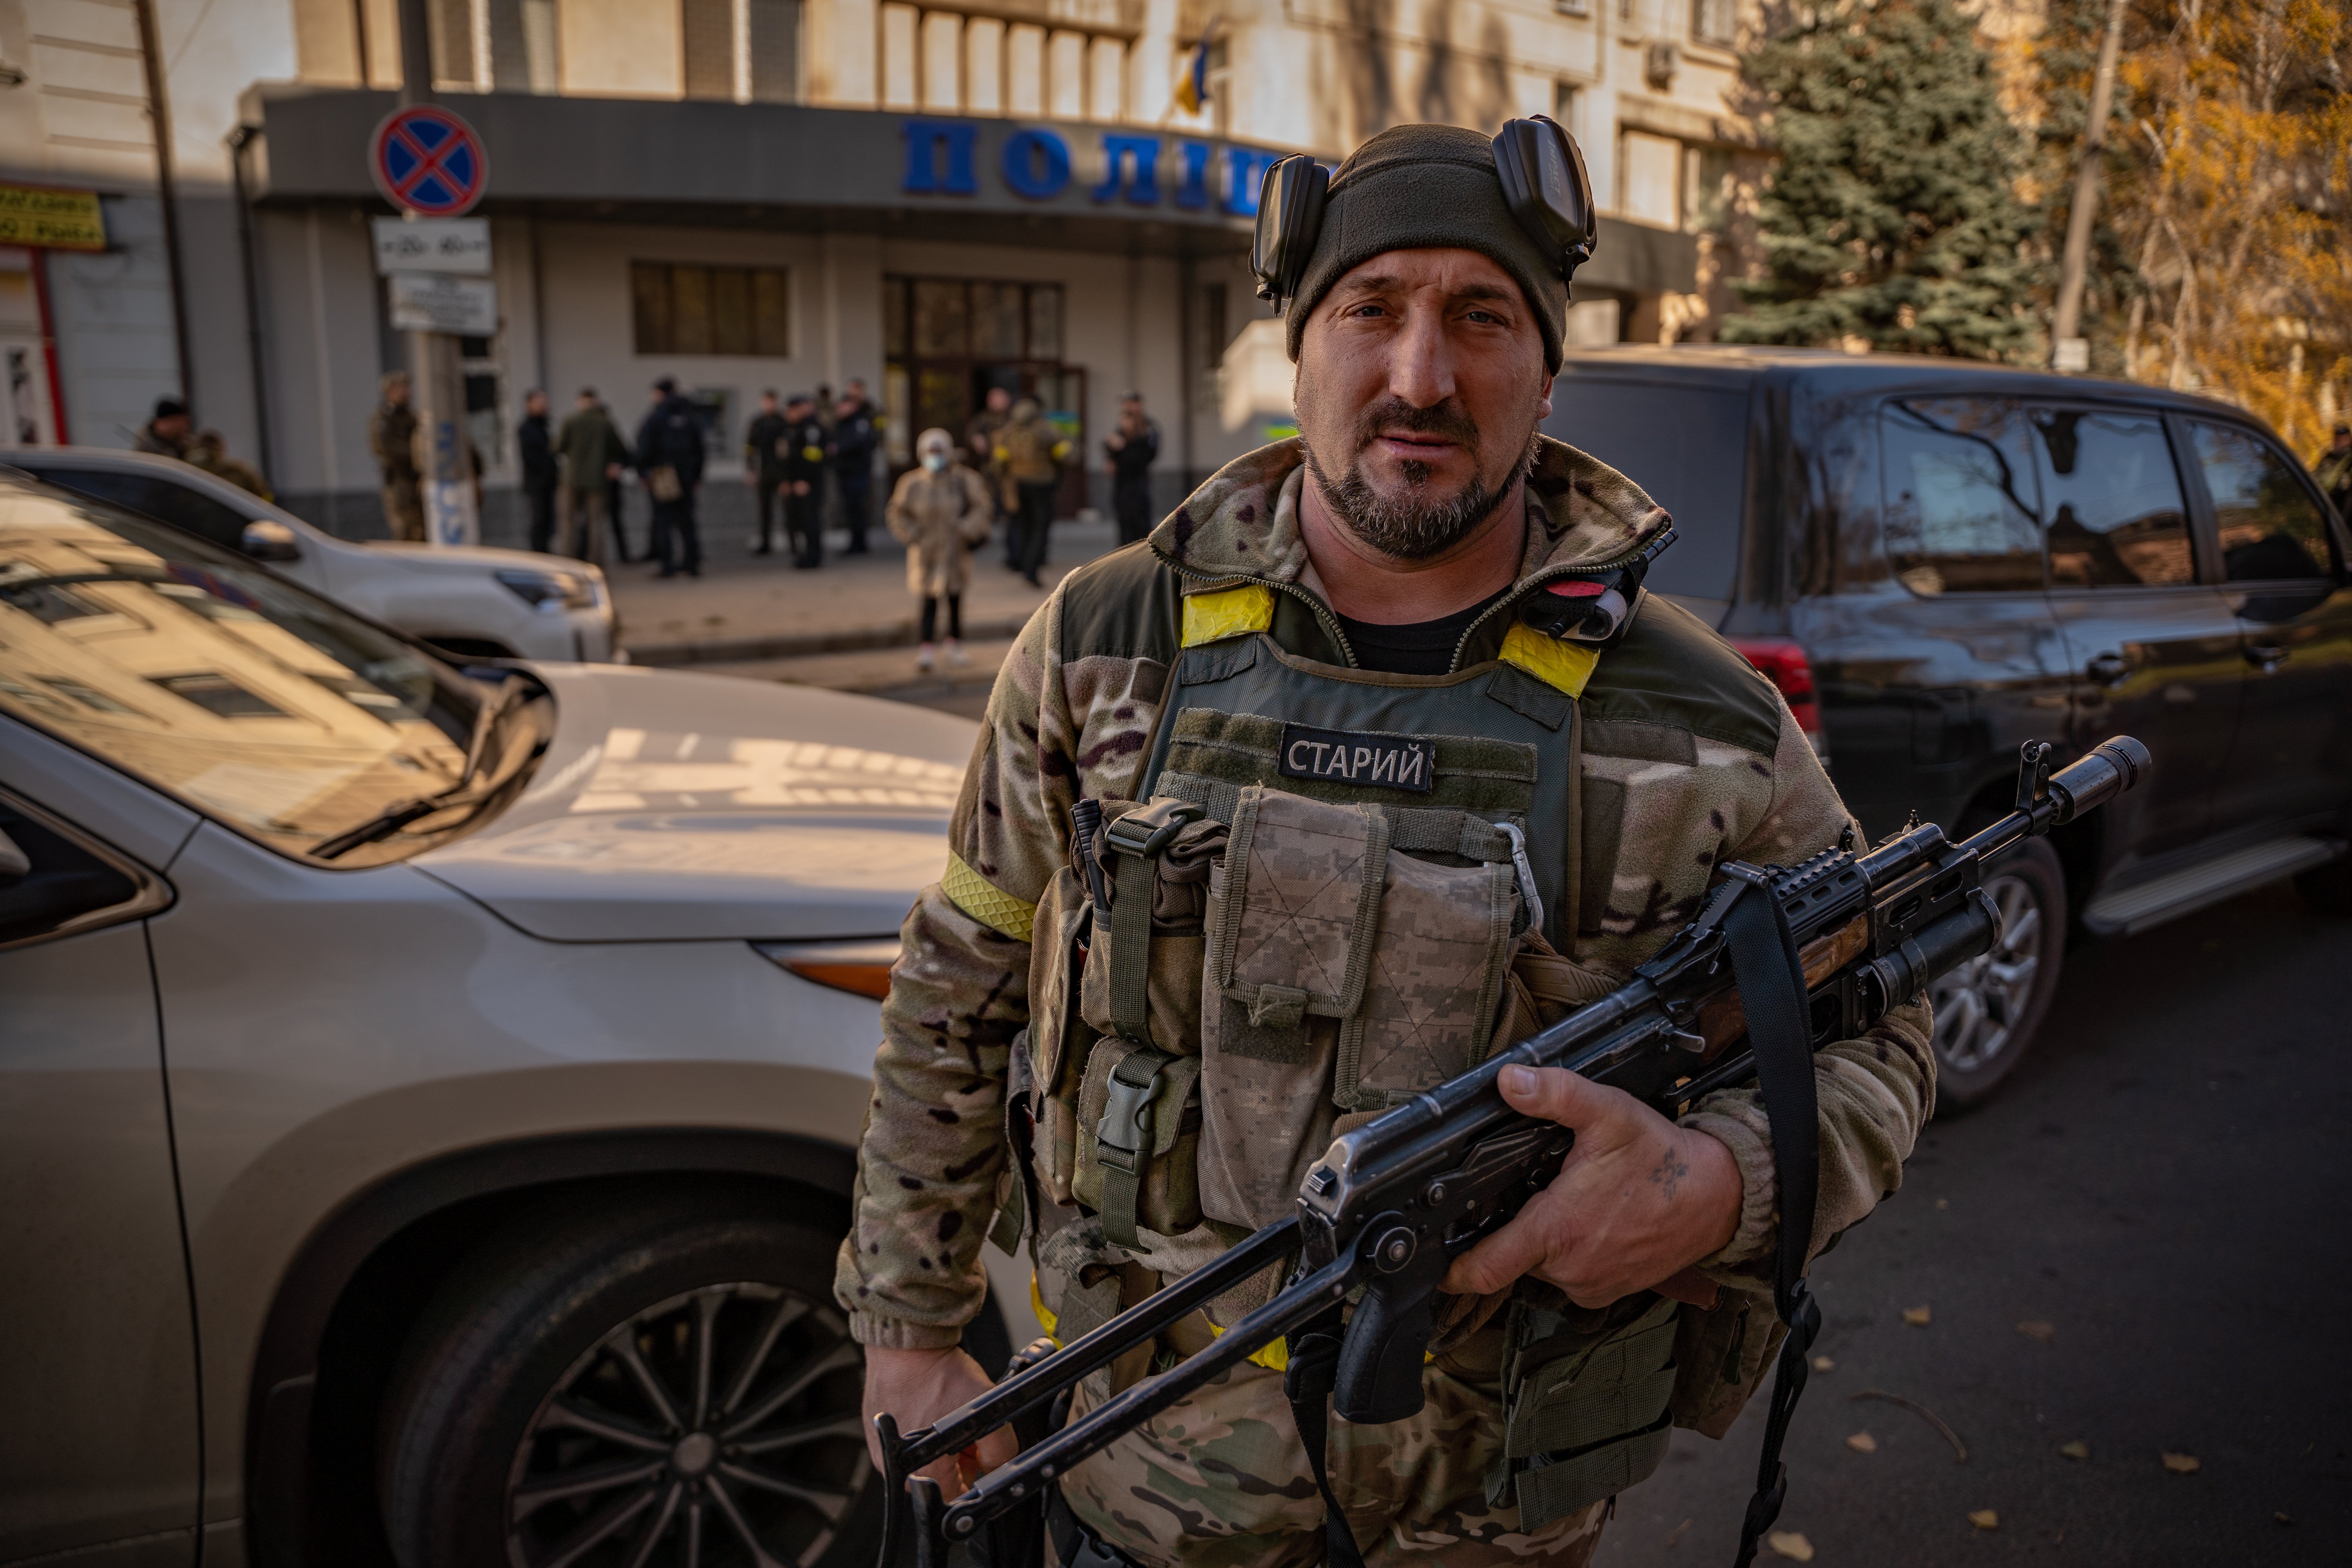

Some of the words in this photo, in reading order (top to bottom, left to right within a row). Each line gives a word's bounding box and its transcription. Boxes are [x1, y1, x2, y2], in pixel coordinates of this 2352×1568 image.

[902, 121, 1340, 217] ПОЛІЦ
[1547, 139, 1561, 197] IMPACT
[1289, 740, 1423, 784] СТАРИЙ
